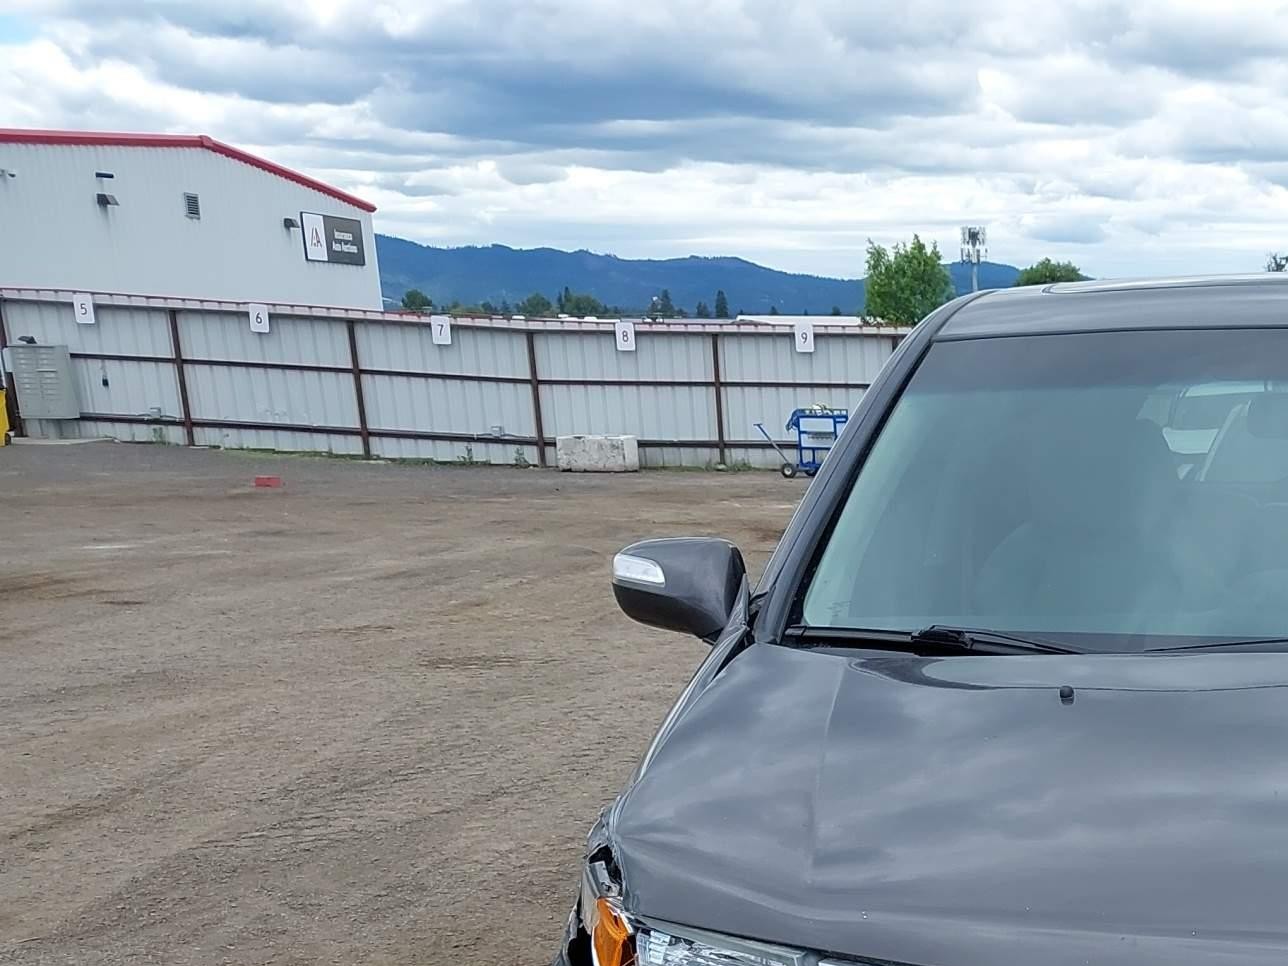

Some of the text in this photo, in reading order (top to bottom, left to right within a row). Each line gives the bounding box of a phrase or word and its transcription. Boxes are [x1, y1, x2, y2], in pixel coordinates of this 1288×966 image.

[80, 303, 88, 316] 5
[255, 312, 263, 324] 6
[437, 323, 444, 336] 7
[622, 330, 629, 343] 8
[800, 331, 808, 345] 9
